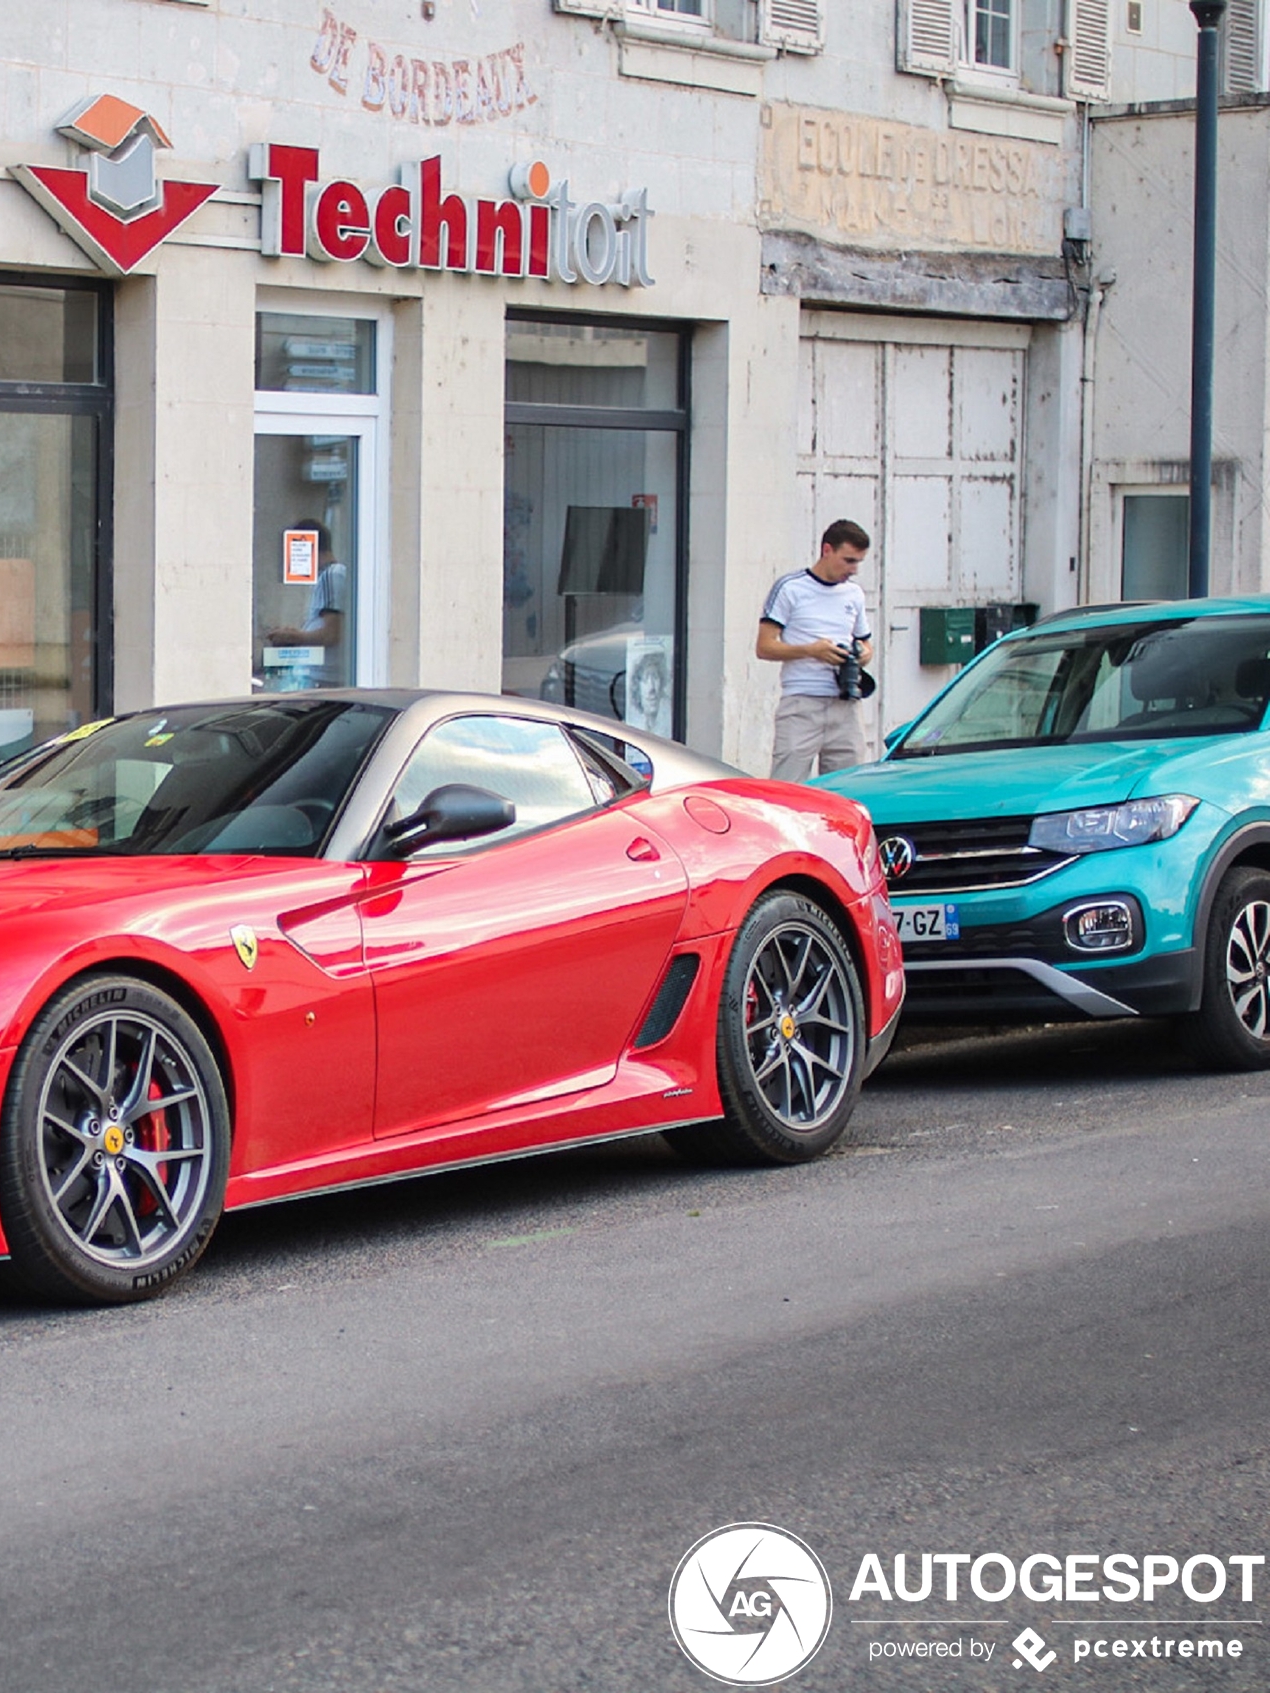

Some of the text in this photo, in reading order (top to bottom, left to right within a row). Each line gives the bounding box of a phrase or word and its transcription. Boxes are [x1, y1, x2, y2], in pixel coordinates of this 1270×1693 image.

[362, 42, 538, 127] BORDEAUX
[250, 142, 655, 288] Technitoit
[946, 923, 960, 936] 69
[57, 988, 124, 1036] MICHELIN
